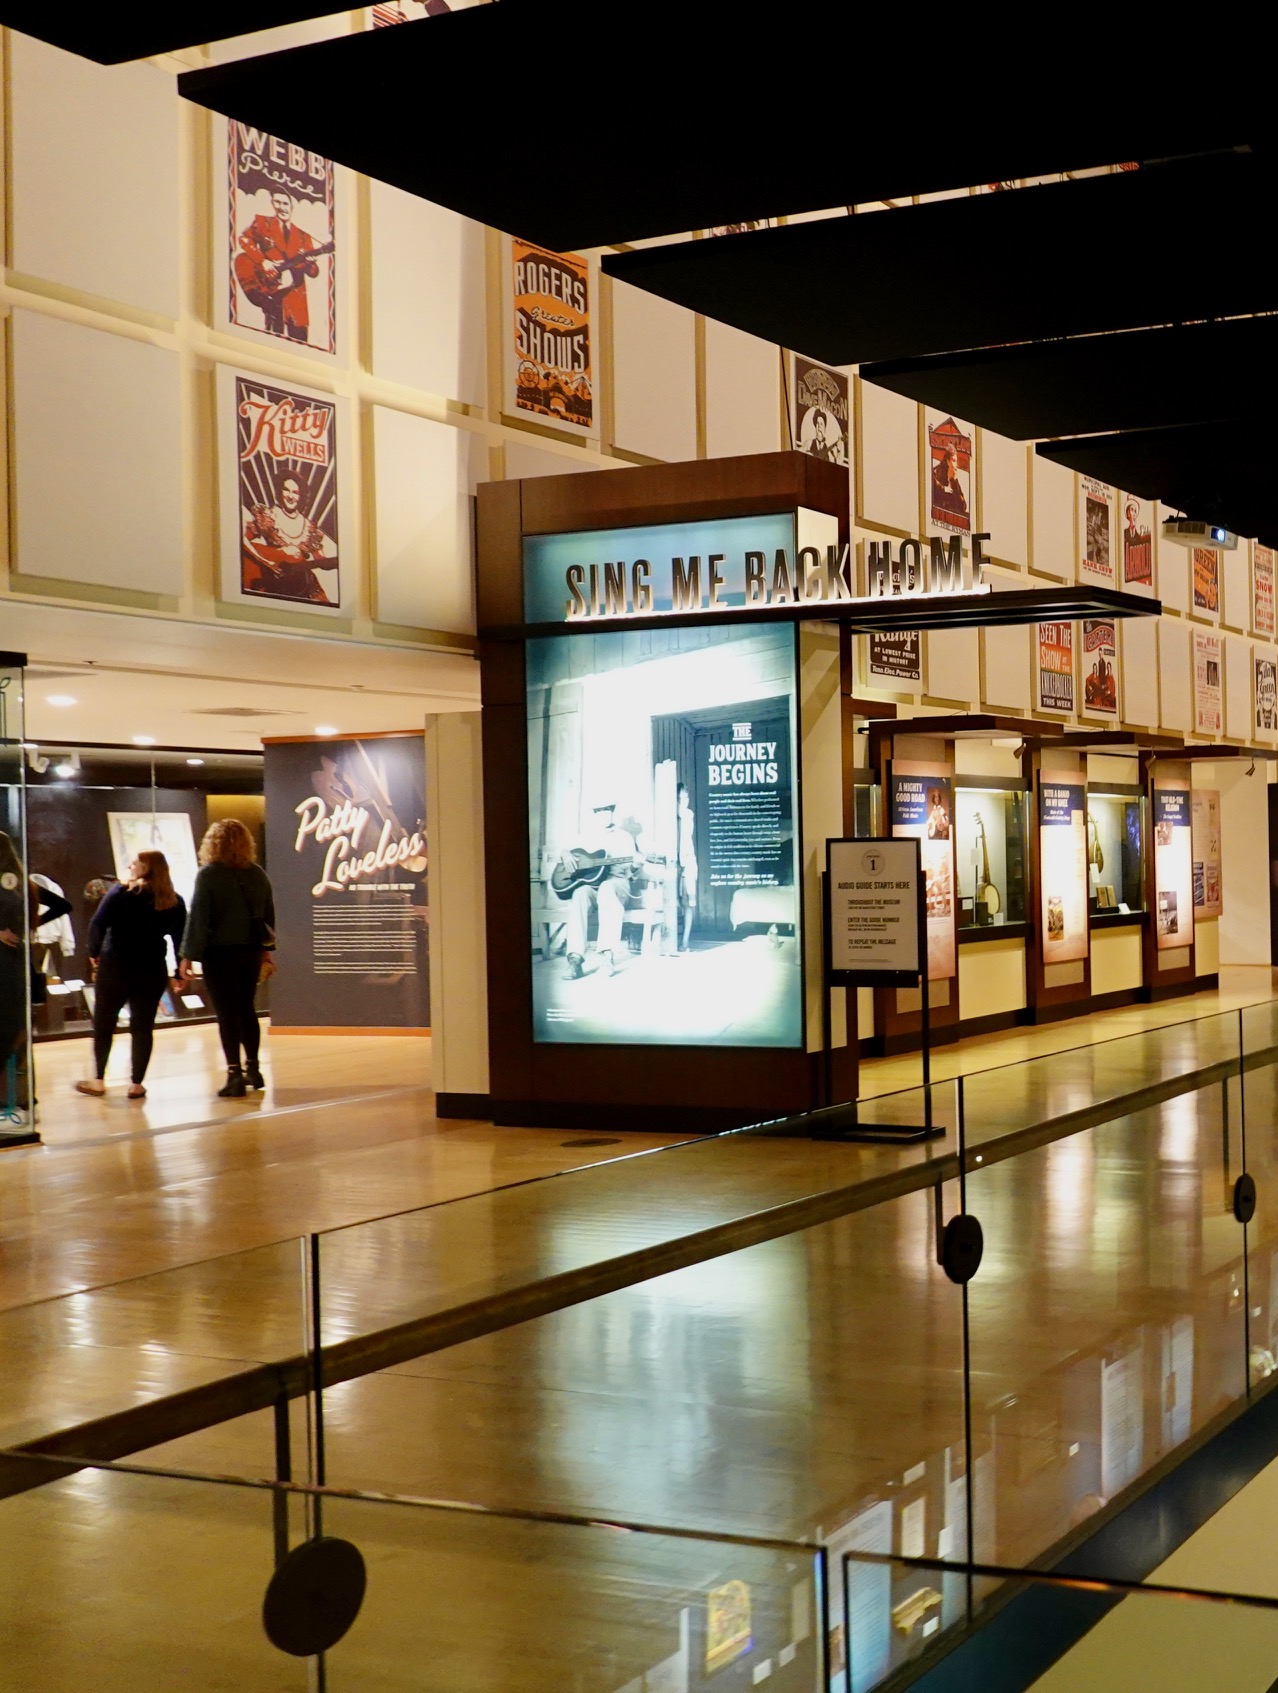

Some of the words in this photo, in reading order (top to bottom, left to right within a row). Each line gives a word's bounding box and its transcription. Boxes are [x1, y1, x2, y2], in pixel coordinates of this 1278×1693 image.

[237, 121, 327, 180] WEBB
[239, 152, 323, 198] Pierce
[515, 261, 586, 316] ROGERS
[530, 305, 576, 327] Greater
[515, 309, 586, 373] SHOWS
[239, 399, 328, 459] Kitty
[282, 436, 325, 460] WELLS
[566, 559, 653, 620] SING
[672, 554, 728, 611] ME
[745, 543, 852, 606] BACK
[869, 533, 992, 598] HOME
[1098, 563, 1113, 574] SNOW
[1255, 580, 1272, 594] SNOW
[1040, 623, 1057, 645] SEEN
[1060, 625, 1071, 648] THE
[1040, 645, 1061, 671] SHOW
[1043, 697, 1055, 706] THIS
[1056, 700, 1072, 708] WEEK
[733, 726, 752, 738] THE
[709, 742, 776, 762] JOURNEY
[708, 763, 778, 786] BEGINS
[896, 793, 910, 802] GOOD
[911, 793, 926, 803] ROAD
[898, 782, 903, 791] A
[903, 782, 923, 792] MIGHTY
[294, 796, 370, 852] Patty
[311, 819, 424, 897] Loveless
[870, 859, 876, 871] 1
